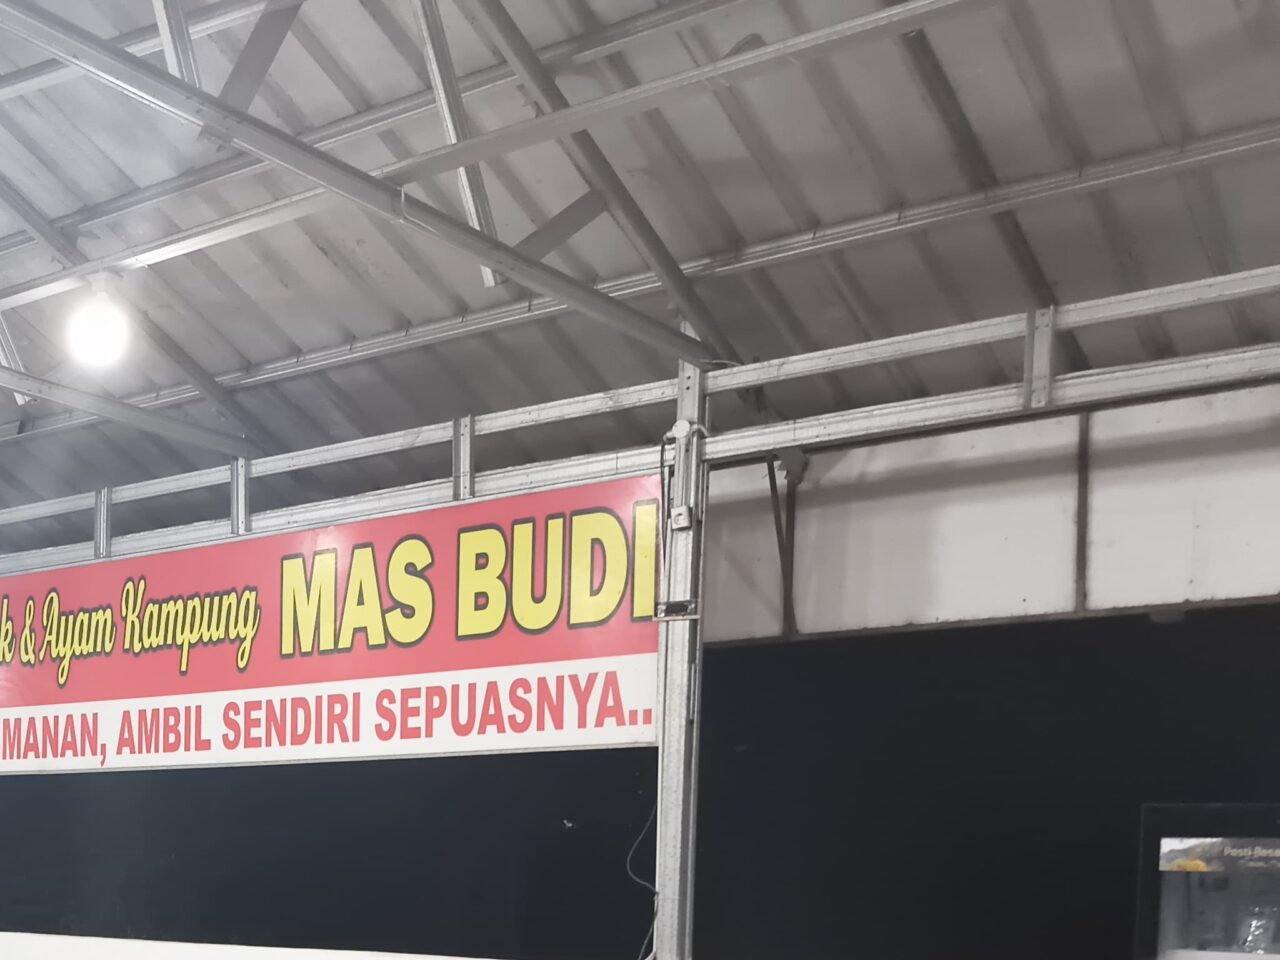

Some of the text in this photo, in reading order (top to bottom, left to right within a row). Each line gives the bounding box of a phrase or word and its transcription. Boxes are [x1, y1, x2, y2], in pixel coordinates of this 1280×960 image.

[19, 616, 37, 666] &
[39, 590, 116, 687] Ayam
[120, 576, 261, 675] Kampung
[280, 535, 436, 657] MAS
[456, 498, 659, 640] BUDI
[116, 699, 212, 756] AMBIL
[222, 682, 361, 751] SENDIRI
[373, 671, 654, 744] SEPUASNYA..
